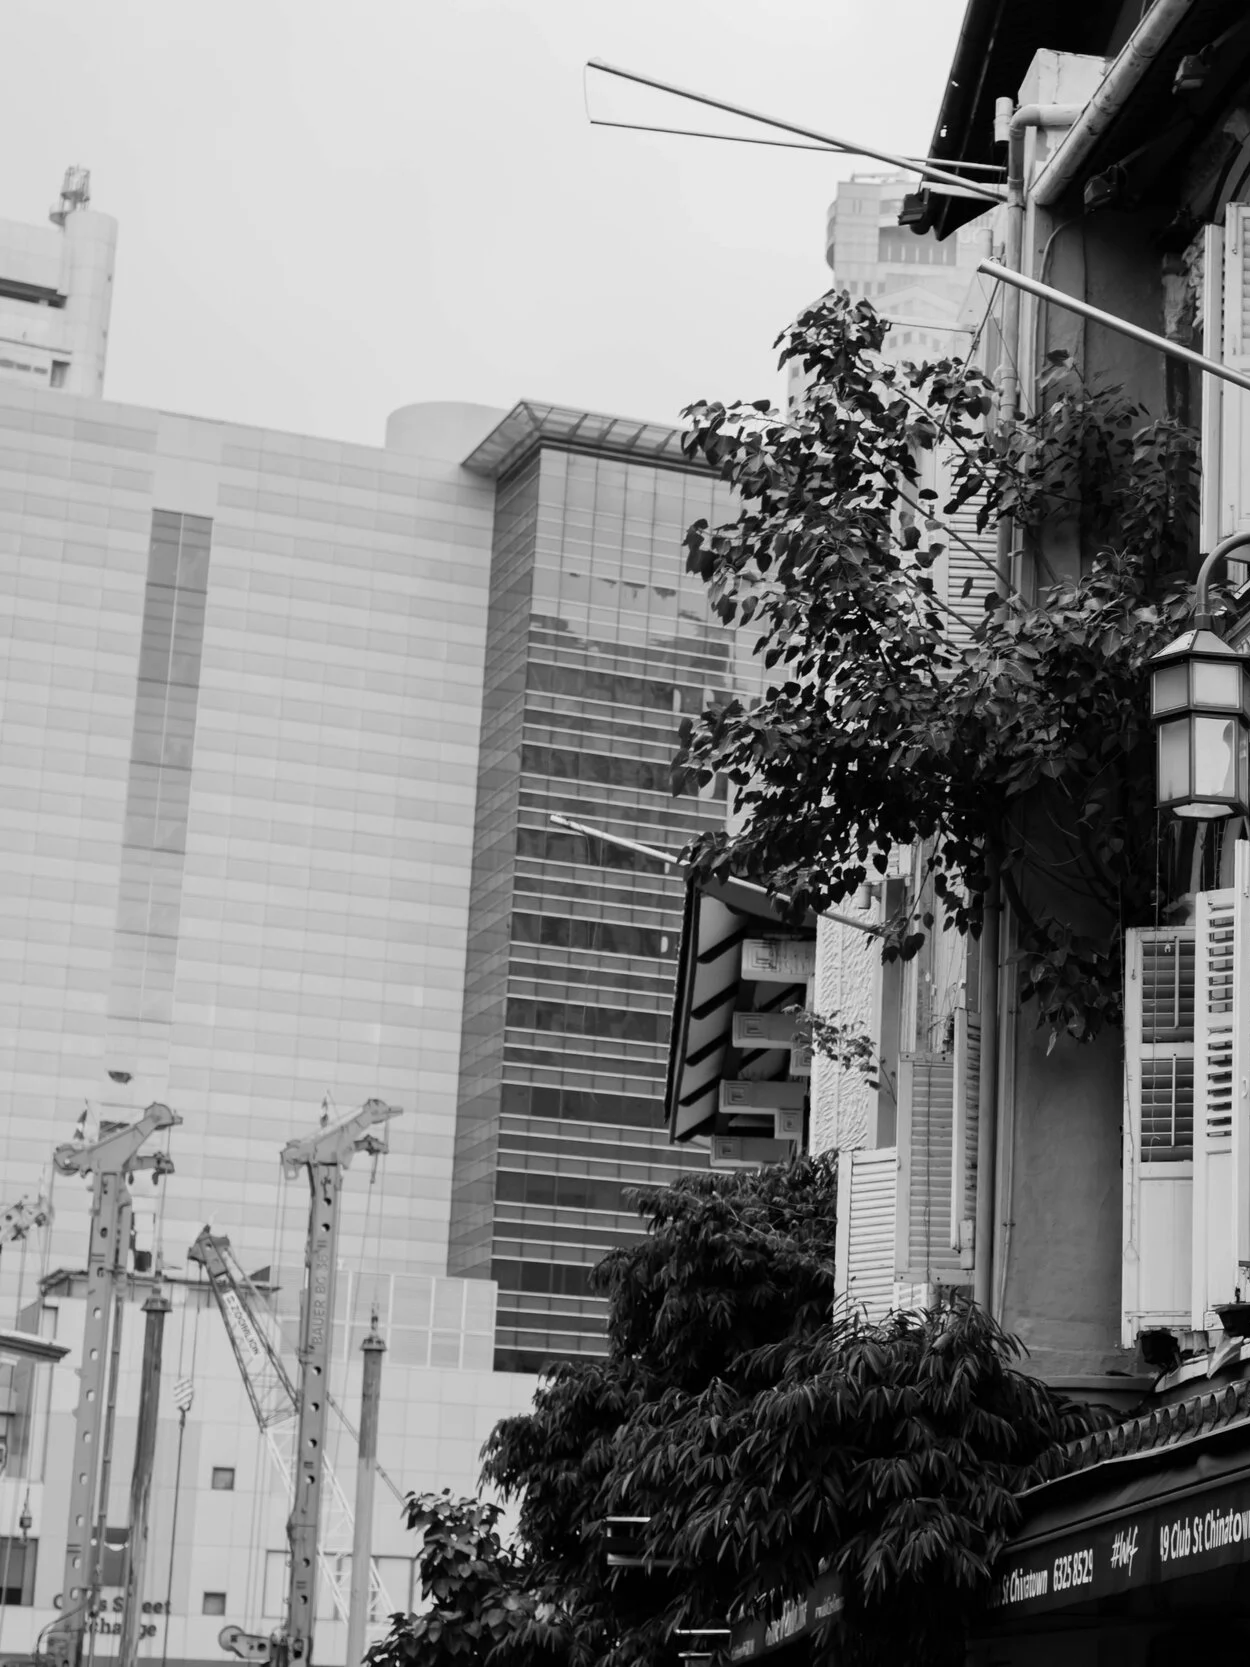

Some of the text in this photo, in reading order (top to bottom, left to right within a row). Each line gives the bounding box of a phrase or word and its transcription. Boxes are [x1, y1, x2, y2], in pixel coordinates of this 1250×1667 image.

[312, 1300, 326, 1346] BAUER
[1170, 1517, 1191, 1559] Club
[1193, 1516, 1203, 1554] St
[1053, 1555, 1072, 1592] 6325
[1072, 1549, 1094, 1586] 8529
[112, 1596, 171, 1615] Seet
